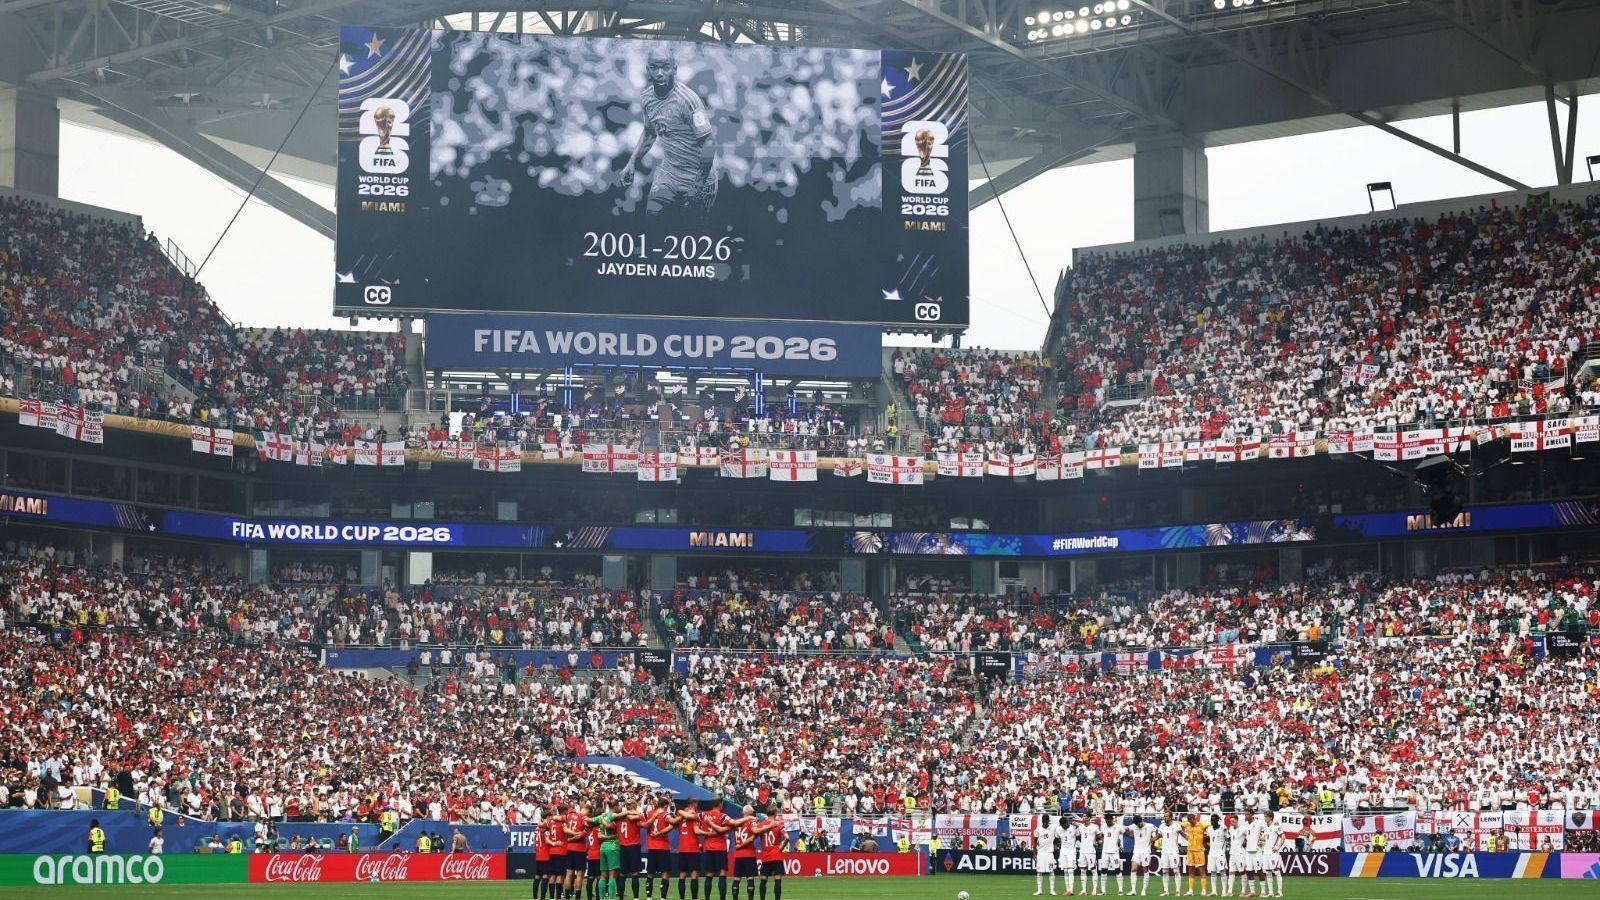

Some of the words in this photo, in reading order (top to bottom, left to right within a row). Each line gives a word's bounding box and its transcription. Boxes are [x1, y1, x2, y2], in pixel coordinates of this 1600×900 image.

[373, 158, 396, 167] FIFA
[359, 175, 389, 184] WORLD
[391, 177, 409, 185] CUP
[915, 179, 936, 188] FIFA
[358, 184, 409, 197] 2026
[361, 201, 406, 213] MIAMI
[901, 196, 931, 204] WORLD
[932, 197, 949, 205] CUP
[901, 204, 949, 216] 2026
[904, 221, 946, 232] MIAMI
[583, 232, 731, 261] 2001-2026
[597, 263, 658, 277] JAYDEN
[661, 264, 716, 278] ADAMS
[474, 329, 541, 354] FIFA
[545, 331, 658, 357] WORLD
[663, 335, 725, 358] CUP
[730, 336, 838, 361] 2026
[1547, 419, 1567, 429] SAFC
[1521, 430, 1560, 439] DURHAM
[1546, 437, 1568, 446] AMELIA
[1407, 512, 1471, 531] MIMI
[232, 521, 265, 540] FIFA
[268, 524, 338, 541] WORLD
[341, 525, 380, 541] CUP
[383, 526, 451, 542] 2026
[689, 531, 754, 547] MIAMI
[1052, 535, 1119, 552] #FIFAWorldCup
[621, 821, 628, 839] 9
[1011, 829, 1031, 837] Jimmy
[1403, 830, 1414, 839] FC
[1506, 825, 1542, 833] LEESTER
[510, 831, 536, 847] FIFA
[588, 832, 595, 846] 6
[765, 830, 776, 847] 10
[33, 855, 164, 884] aramco
[827, 854, 890, 875] Lenovo
[957, 854, 997, 871] ADI
[1410, 853, 1480, 878] VISA
